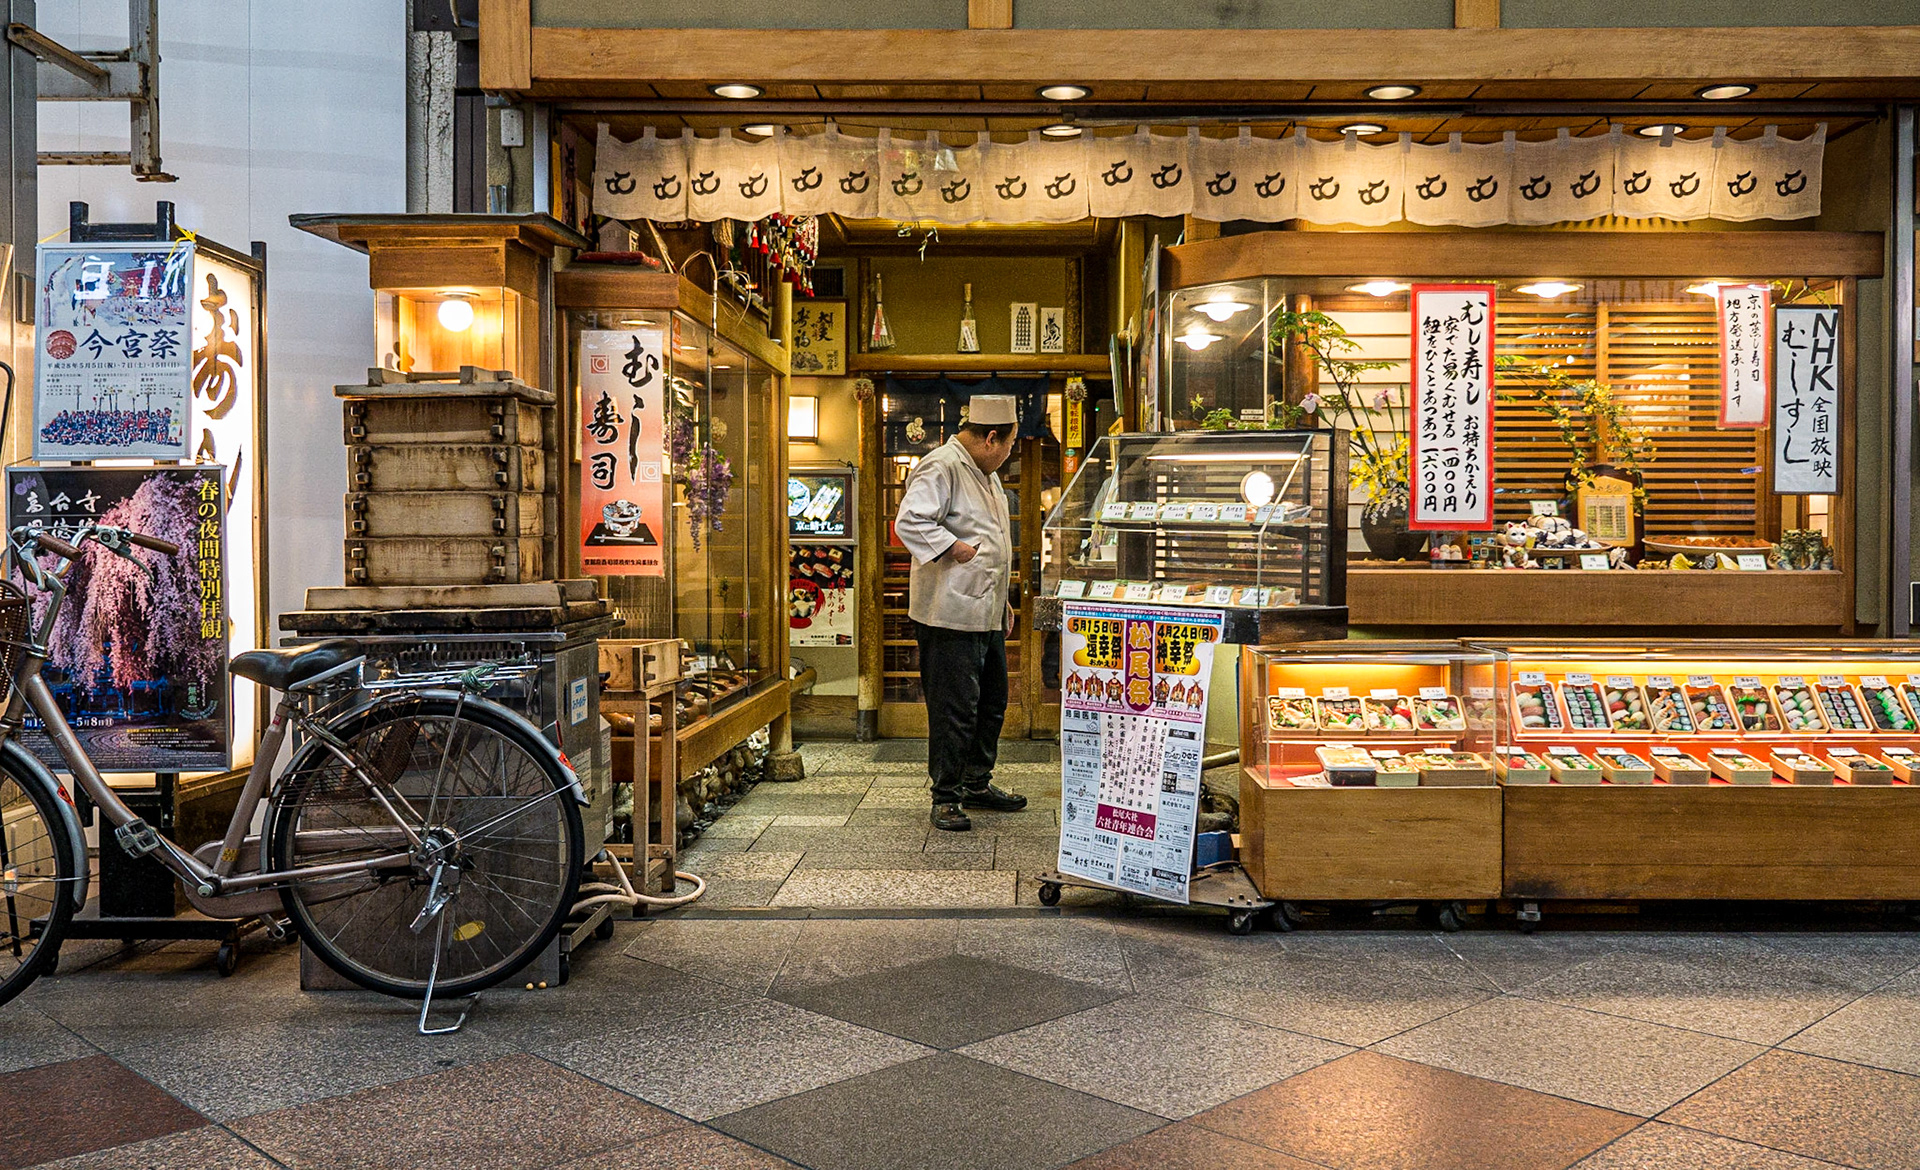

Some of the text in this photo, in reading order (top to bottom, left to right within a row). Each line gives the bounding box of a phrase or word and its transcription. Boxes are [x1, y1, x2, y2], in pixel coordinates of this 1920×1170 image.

[80, 328, 181, 360] 今宮祭
[1423, 315, 1442, 441] 紐をひくとあつあつ
[1726, 299, 1745, 408] 地方発送承ります
[1746, 294, 1762, 382] 京の蒸し寿司
[621, 334, 660, 486] むし
[1460, 300, 1487, 511] むし寿し お持ちかえり
[1780, 320, 1810, 464] むしすし
[1809, 312, 1839, 479] NHK 全国放映
[586, 390, 625, 492] 寿司
[198, 480, 222, 640] 春の夜間特別拝観
[1072, 619, 1123, 635] 5月15日(日)
[1089, 659, 1119, 668] おかえり
[1127, 621, 1152, 706] 松尾祭
[1156, 624, 1214, 641] 4月24日(日)
[1162, 665, 1187, 674] おいで
[1095, 816, 1155, 839] 六社青年連合会
[1112, 808, 1139, 823] 松尾大社
